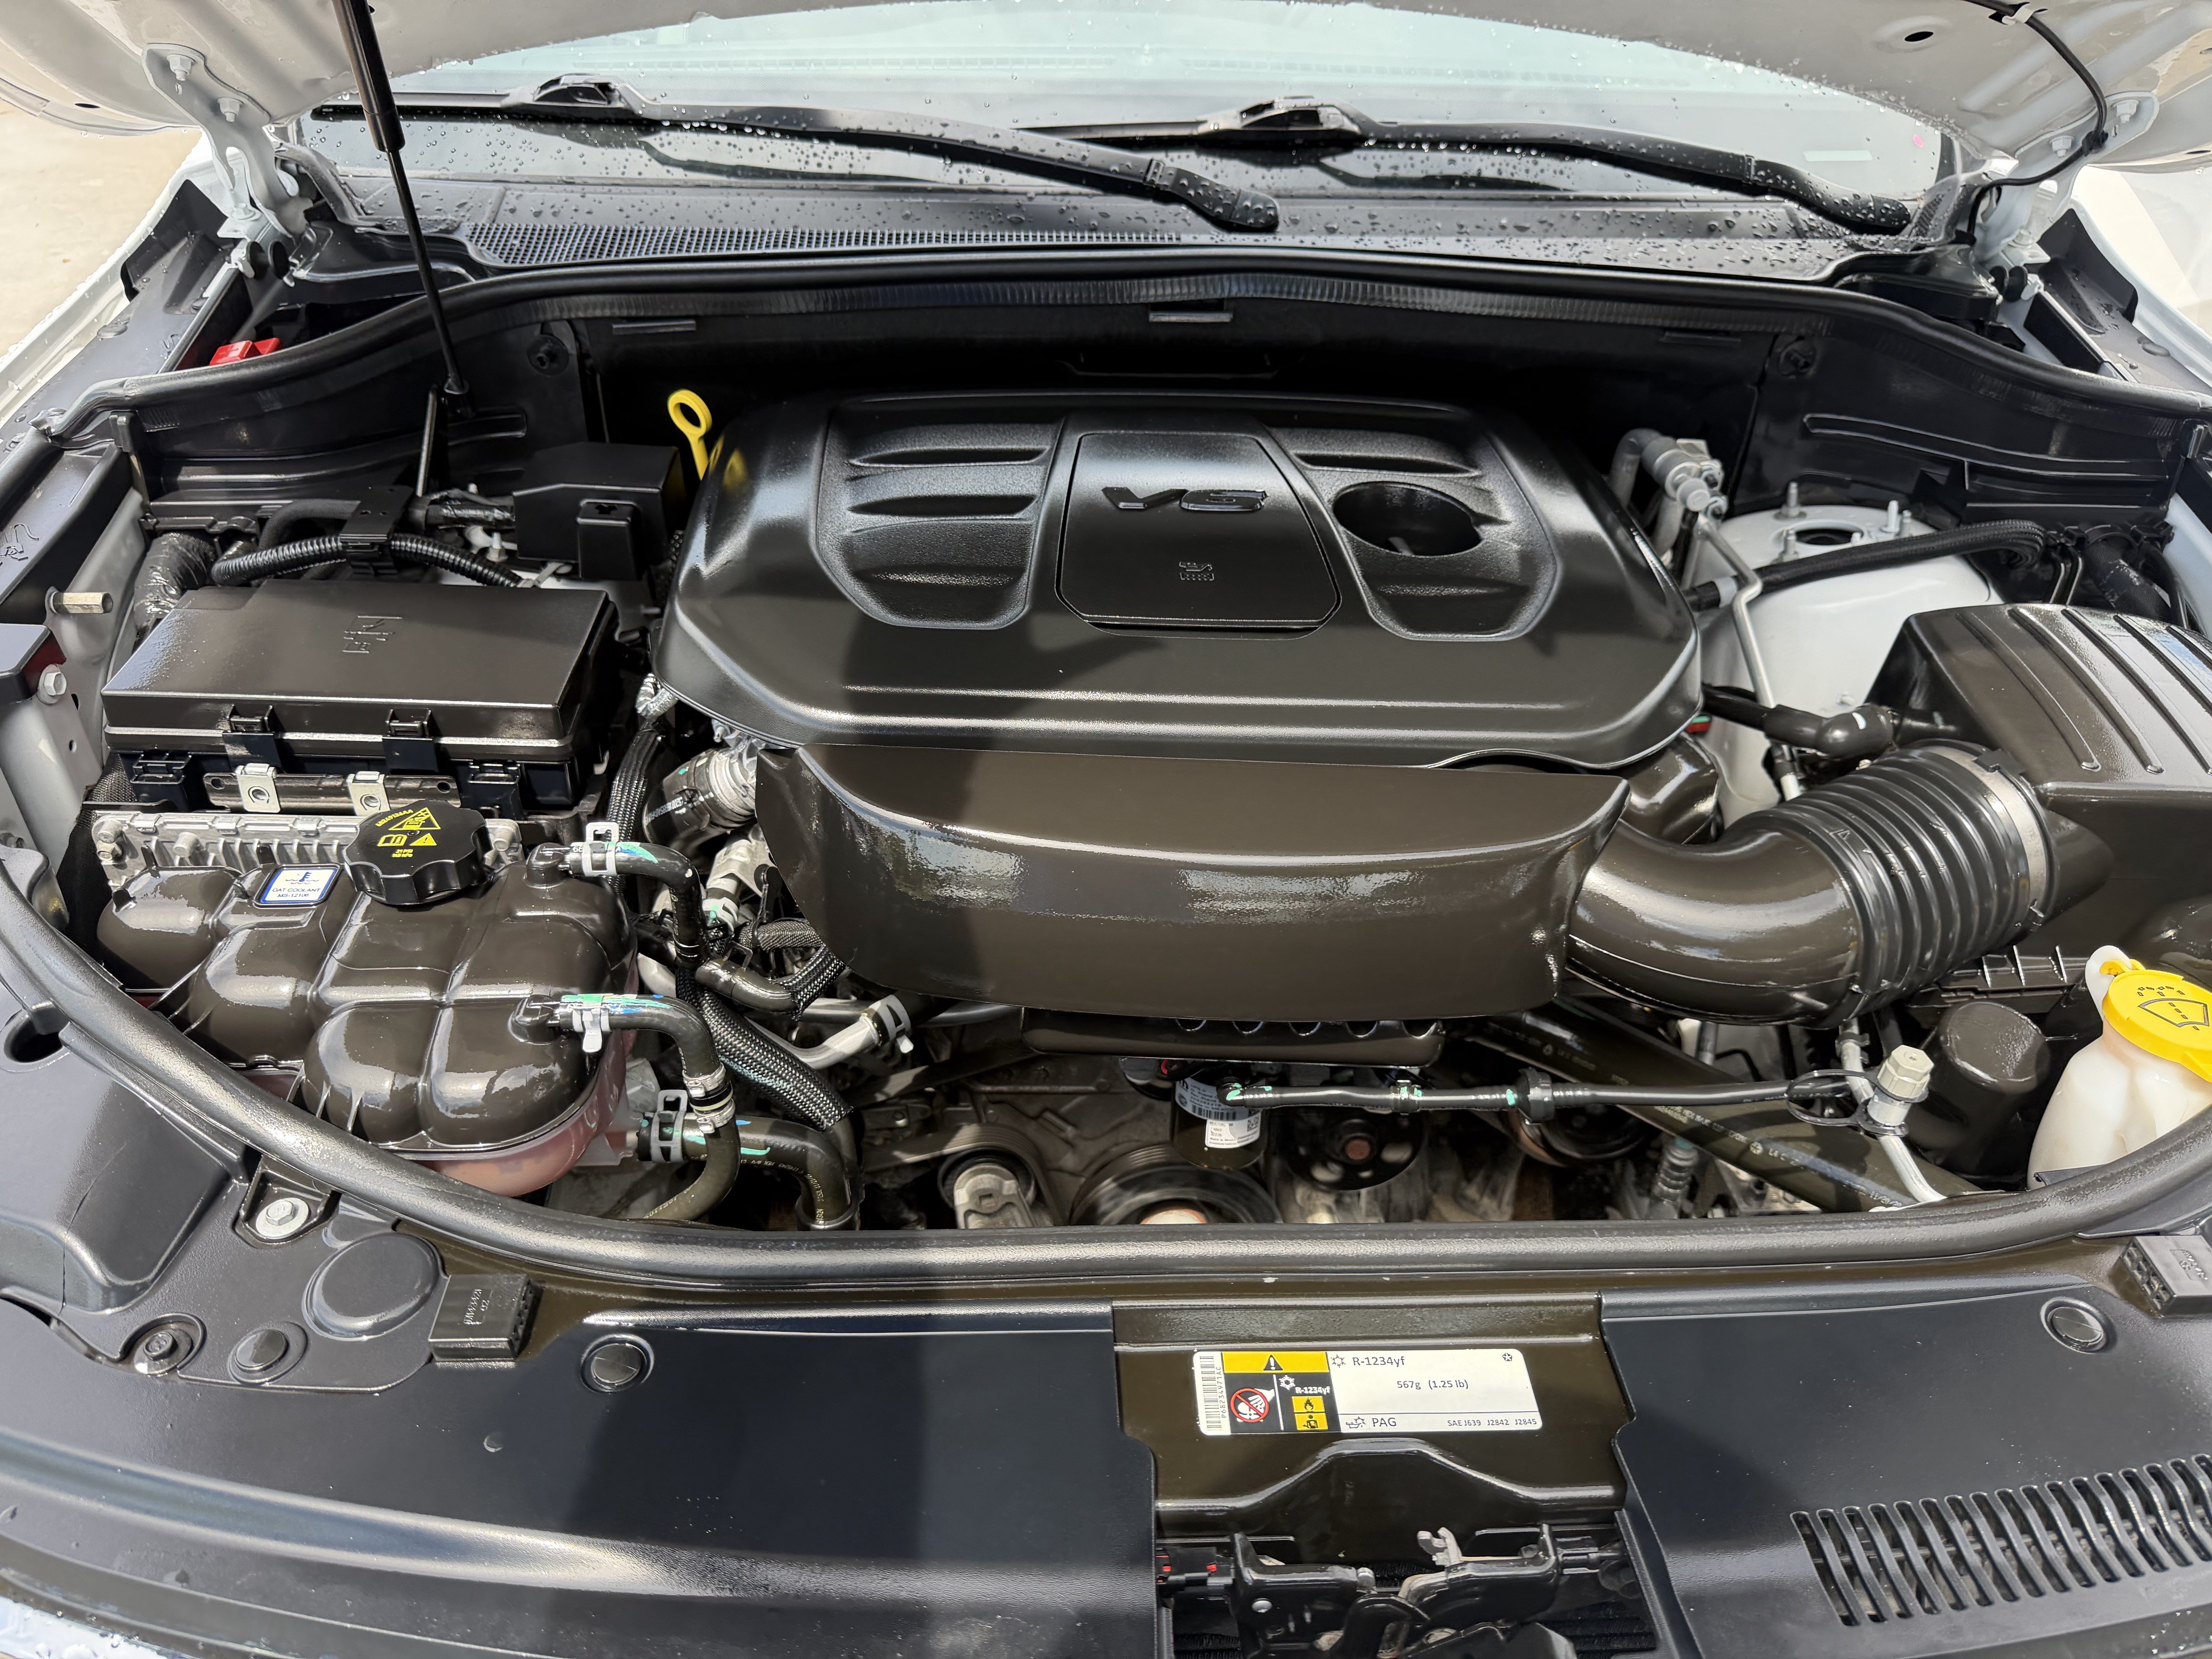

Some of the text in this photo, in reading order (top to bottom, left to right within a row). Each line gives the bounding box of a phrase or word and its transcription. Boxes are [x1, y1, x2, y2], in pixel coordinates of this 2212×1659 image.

[1102, 487, 1269, 511] V6
[1353, 1356, 1405, 1367] R-1234yf
[1397, 1379, 1469, 1390] 567g (1.25 lb)
[1216, 1367, 1227, 1418] P68234971AC
[1371, 1417, 1397, 1427] PAG
